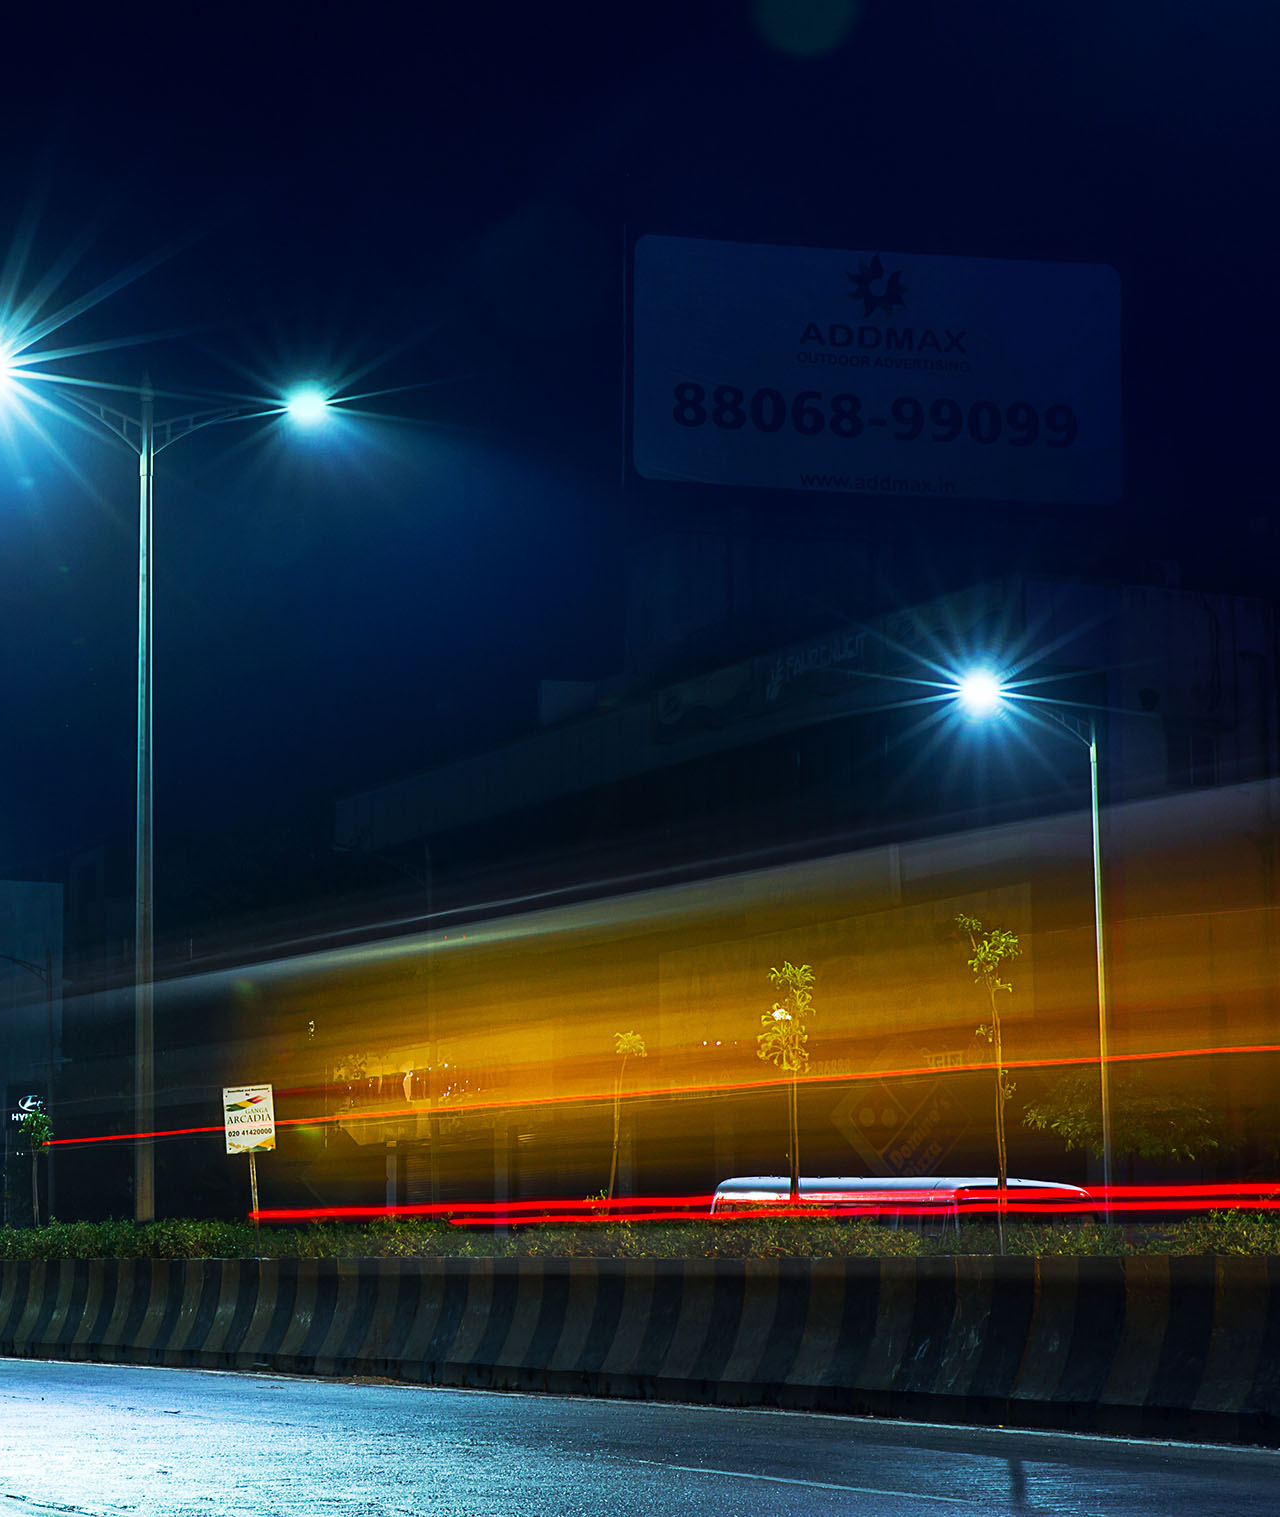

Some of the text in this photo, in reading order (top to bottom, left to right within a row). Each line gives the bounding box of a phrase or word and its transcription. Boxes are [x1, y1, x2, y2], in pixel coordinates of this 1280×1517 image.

[799, 322, 967, 353] ADDMAX
[796, 351, 971, 374] OUTDOOR ADVERTISING
[672, 381, 1079, 447] 88068-99099
[799, 472, 956, 494] www.addmax.in
[228, 1113, 271, 1124] ARCADIA
